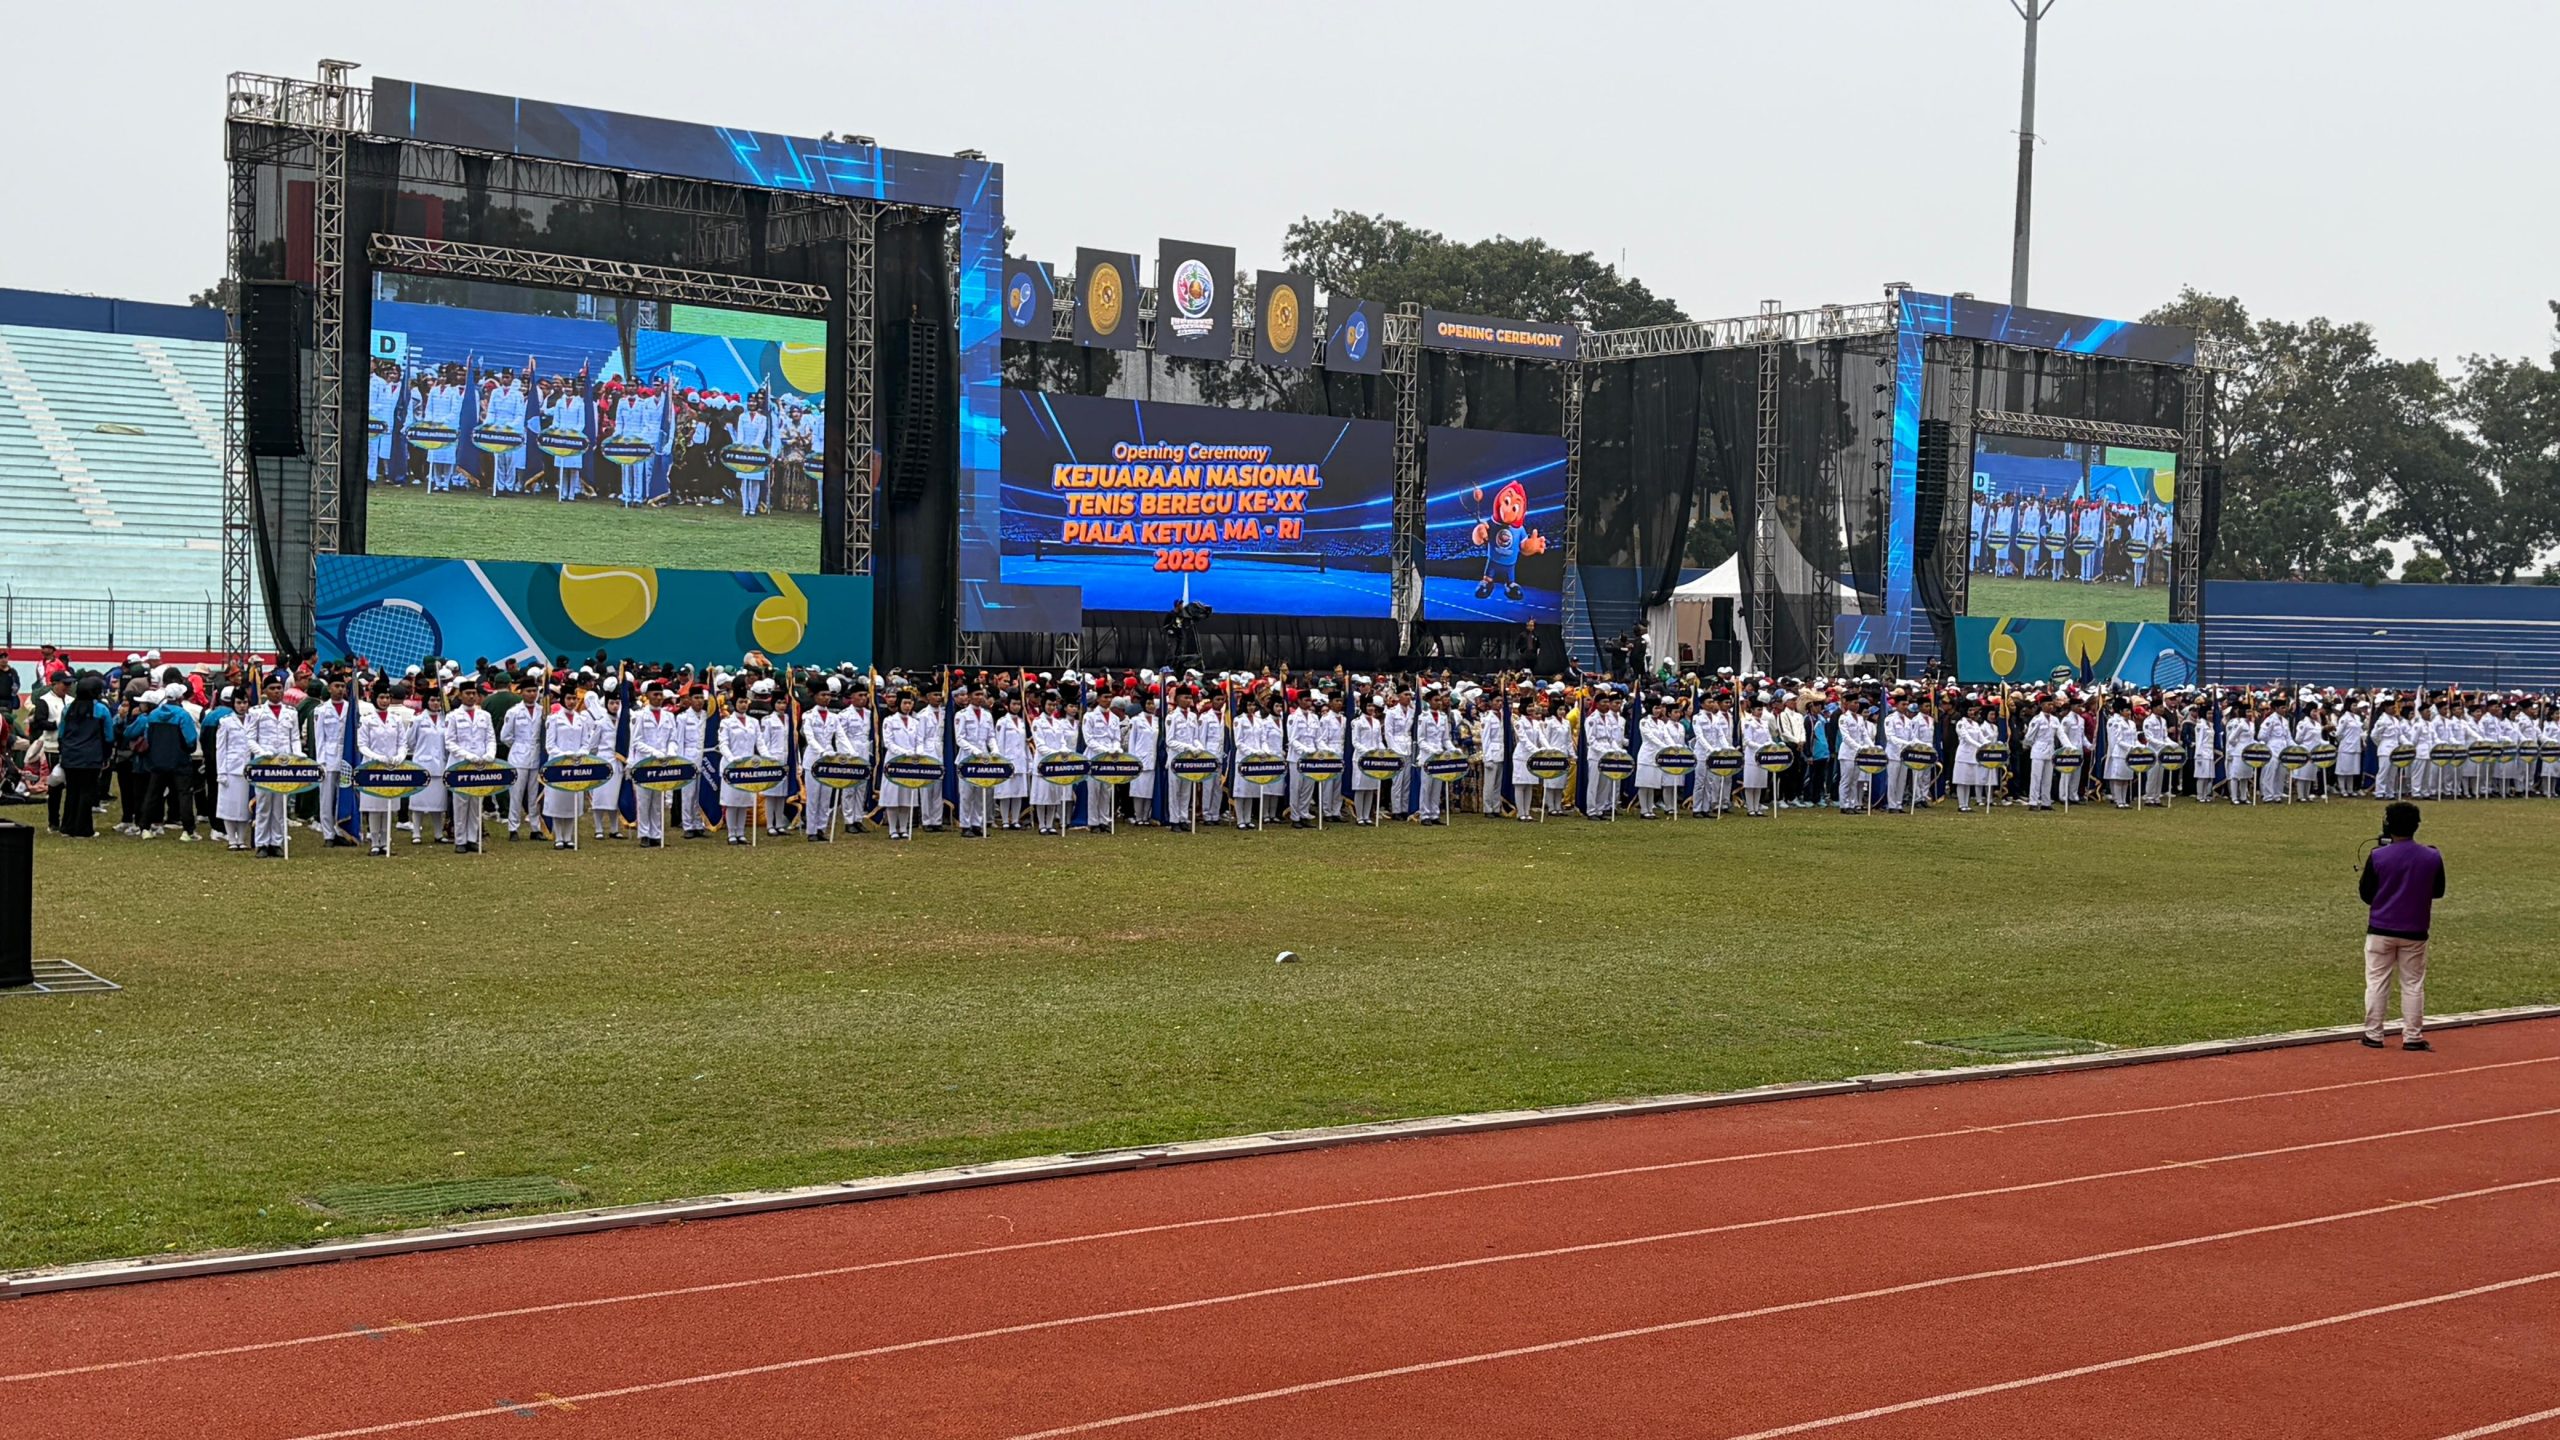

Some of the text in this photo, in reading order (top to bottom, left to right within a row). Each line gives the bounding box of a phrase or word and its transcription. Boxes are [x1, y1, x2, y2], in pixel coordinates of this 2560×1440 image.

[380, 336, 396, 353] D
[1438, 322, 1563, 347] OPENING CEREMONY
[1114, 441, 1269, 463] Opening Ceremony
[1054, 464, 1320, 488] KEJUARAAN NASIONAL
[1977, 476, 1984, 487] D
[1066, 490, 1306, 515] TENIS BEREGU KE-XX
[1063, 520, 1136, 543] PIALA
[1142, 520, 1218, 543] KETUA
[1223, 519, 1260, 541] MA
[1278, 519, 1303, 540] RI
[1154, 550, 1210, 571] 2026
